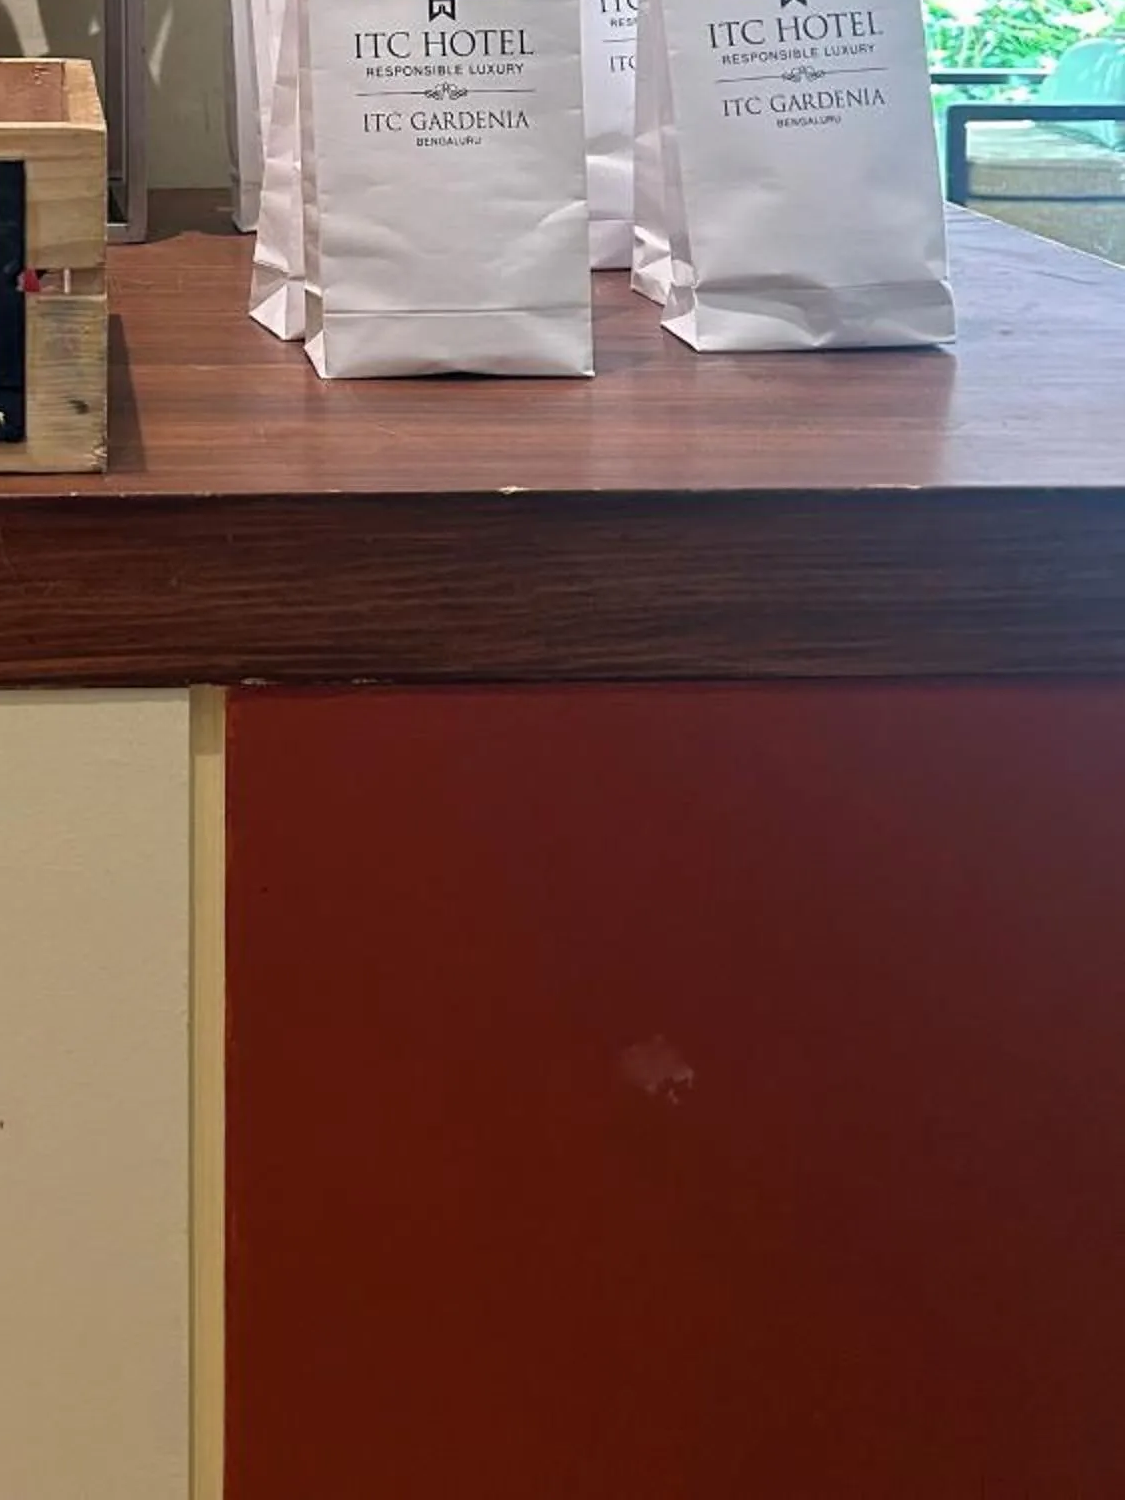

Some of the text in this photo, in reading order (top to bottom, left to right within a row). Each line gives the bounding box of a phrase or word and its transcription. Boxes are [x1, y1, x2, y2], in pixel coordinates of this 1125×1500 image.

[706, 10, 884, 49] ITC HOTEL
[355, 29, 535, 60] ITC HOTEL
[721, 43, 876, 66] RESPONSIBLE LUXURY
[366, 62, 525, 78] RESPONSIBLE LUXURY
[722, 87, 886, 118] ITC GARDENIA
[363, 109, 531, 133] ITC GARDENIA
[776, 114, 842, 129] BENGALURU
[416, 135, 483, 148] BENGALURU
